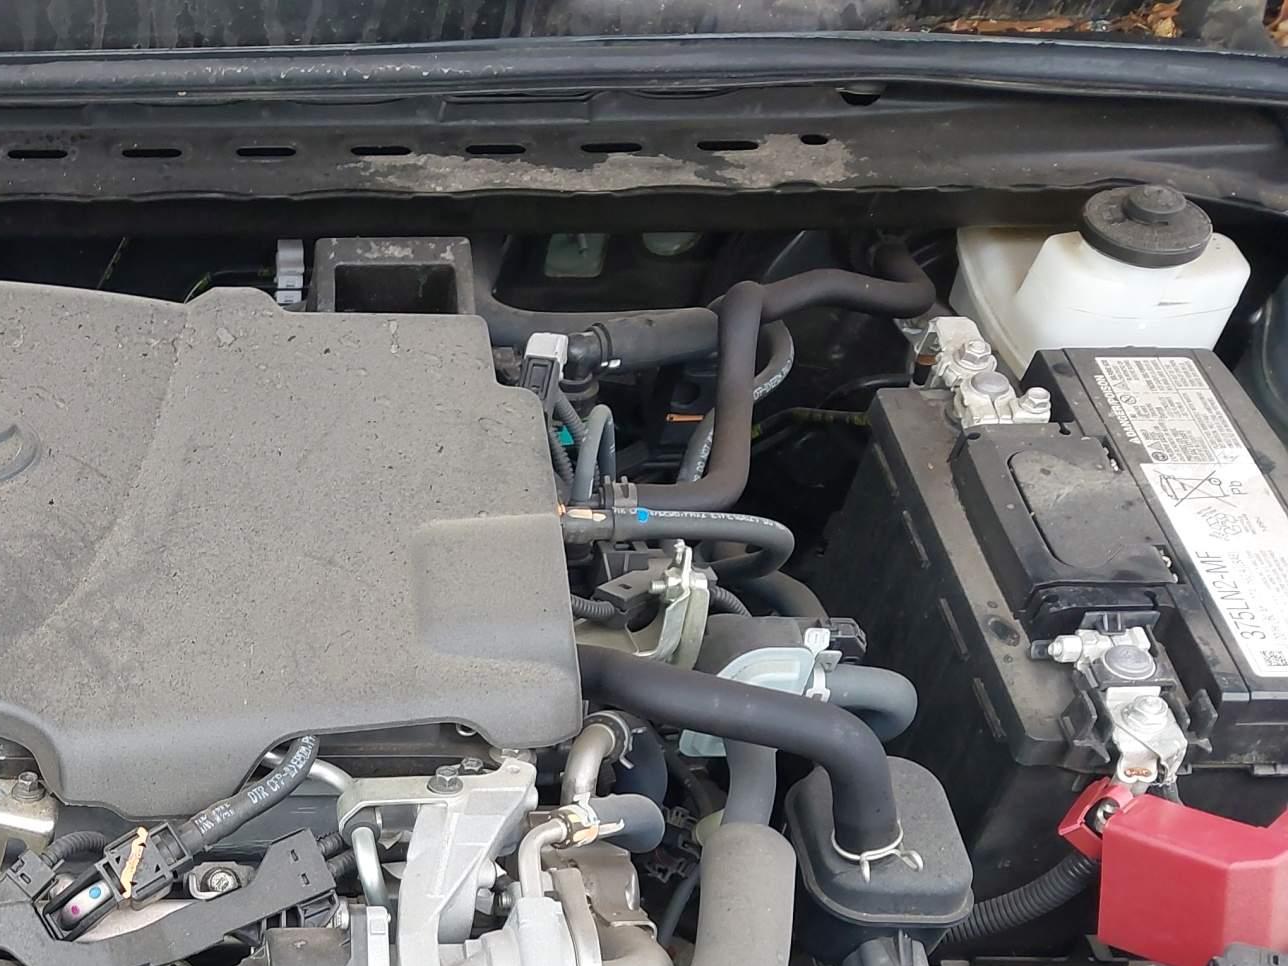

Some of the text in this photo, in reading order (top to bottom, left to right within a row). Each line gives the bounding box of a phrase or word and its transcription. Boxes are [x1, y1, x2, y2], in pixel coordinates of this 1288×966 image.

[1229, 480, 1249, 495] Pb
[1195, 551, 1266, 640] 375LN2-MF
[247, 785, 269, 804] DTR
